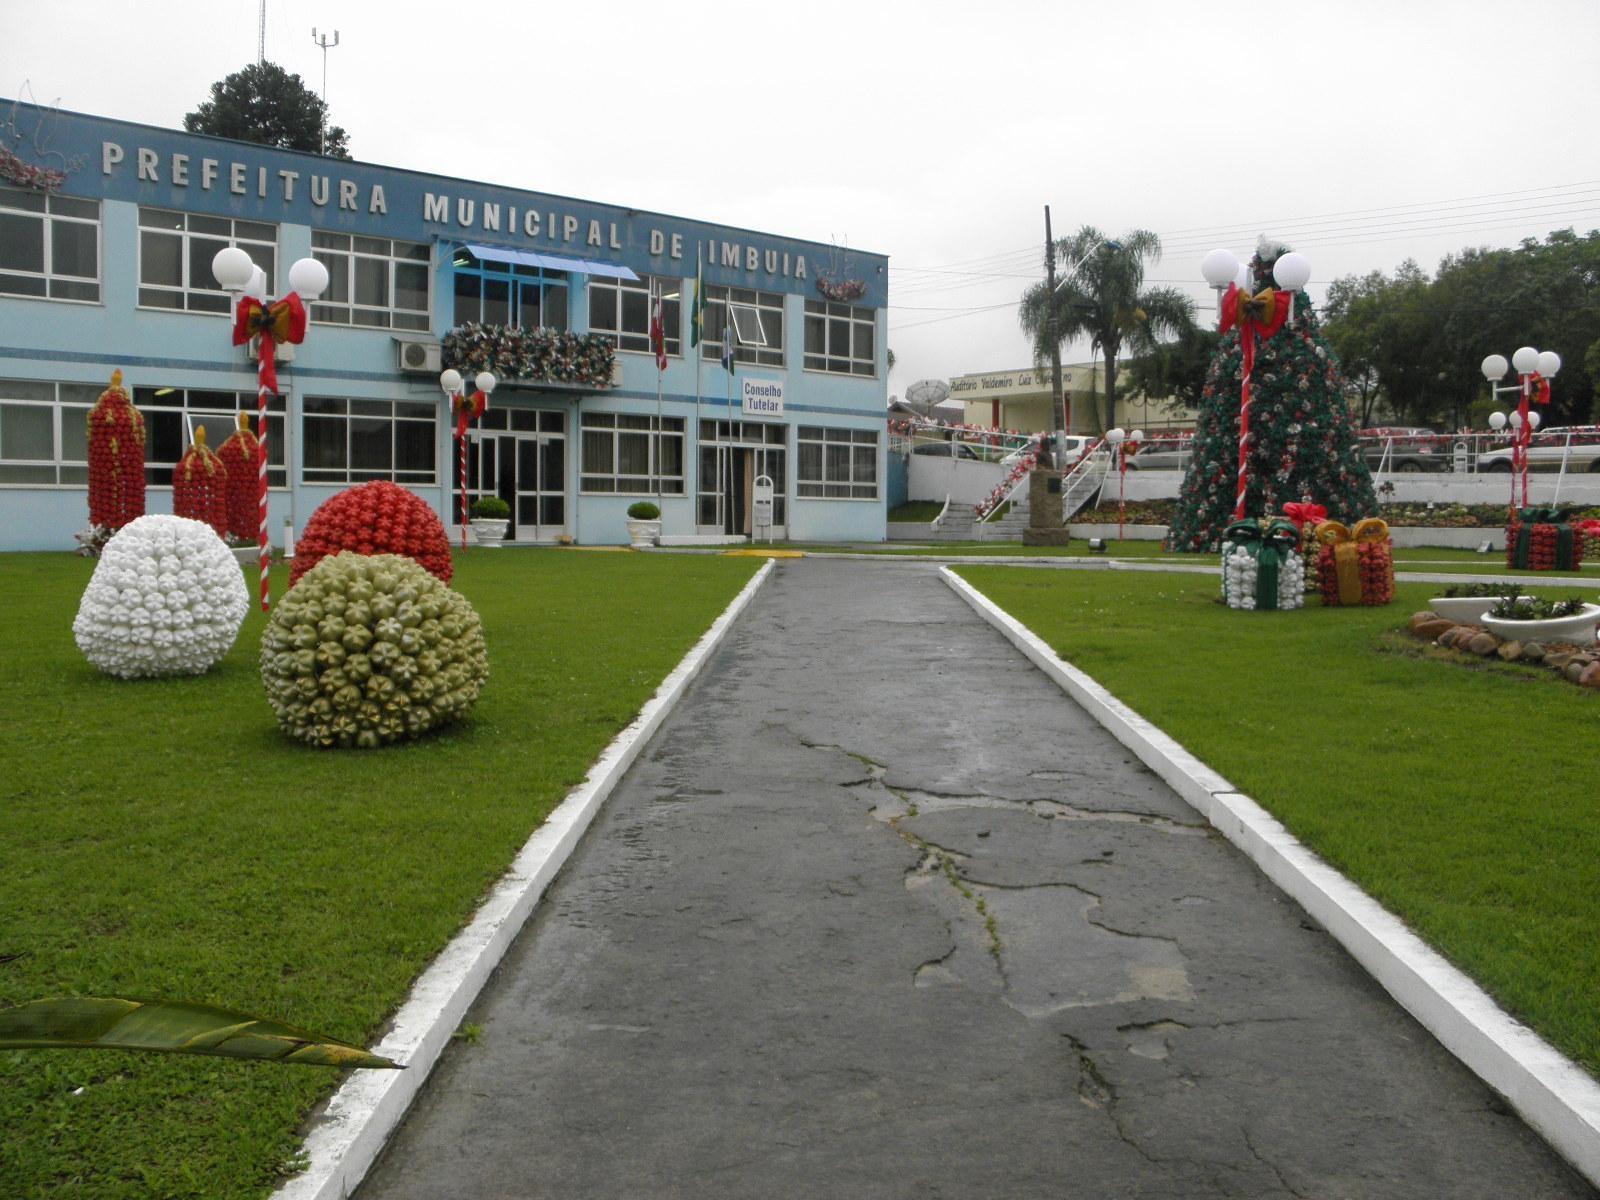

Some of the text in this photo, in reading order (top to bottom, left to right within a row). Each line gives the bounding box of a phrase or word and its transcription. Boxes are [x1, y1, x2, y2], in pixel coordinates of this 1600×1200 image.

[102, 141, 806, 278] PREFEITURA MUNICIPAL DE IMBUIA
[745, 382, 782, 397] Conselho
[749, 398, 779, 411] Tutelar
